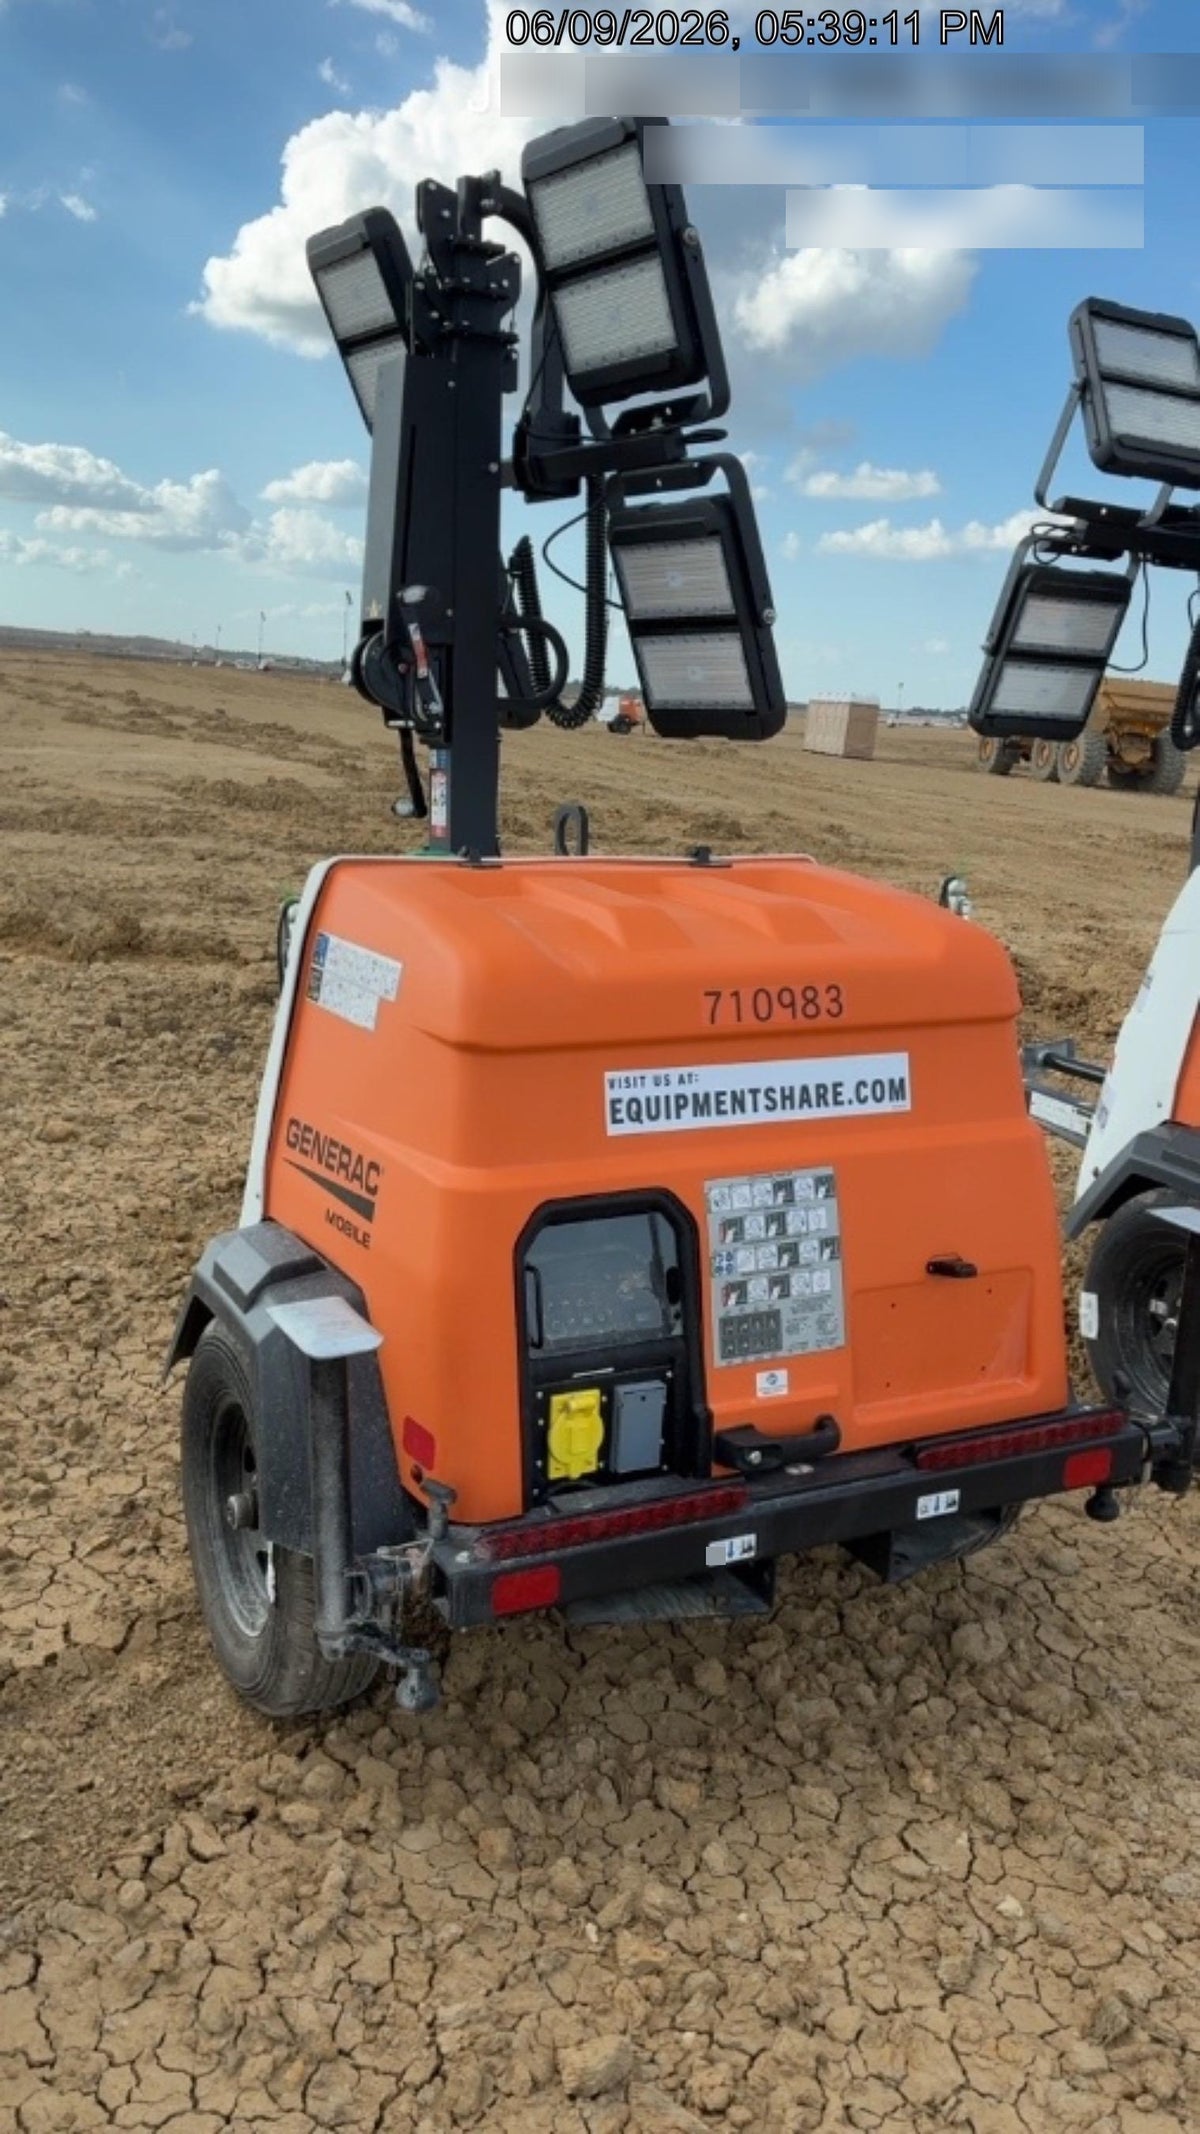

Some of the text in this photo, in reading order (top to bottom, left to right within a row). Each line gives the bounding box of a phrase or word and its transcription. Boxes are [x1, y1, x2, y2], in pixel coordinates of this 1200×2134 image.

[703, 984, 844, 1024] 710983
[608, 1072, 700, 1089] VISIT US AT:
[609, 1077, 907, 1125] EQUIPMENTSHARE.COM
[286, 1117, 381, 1196] GENERAC
[324, 1208, 371, 1250] MOBILE
